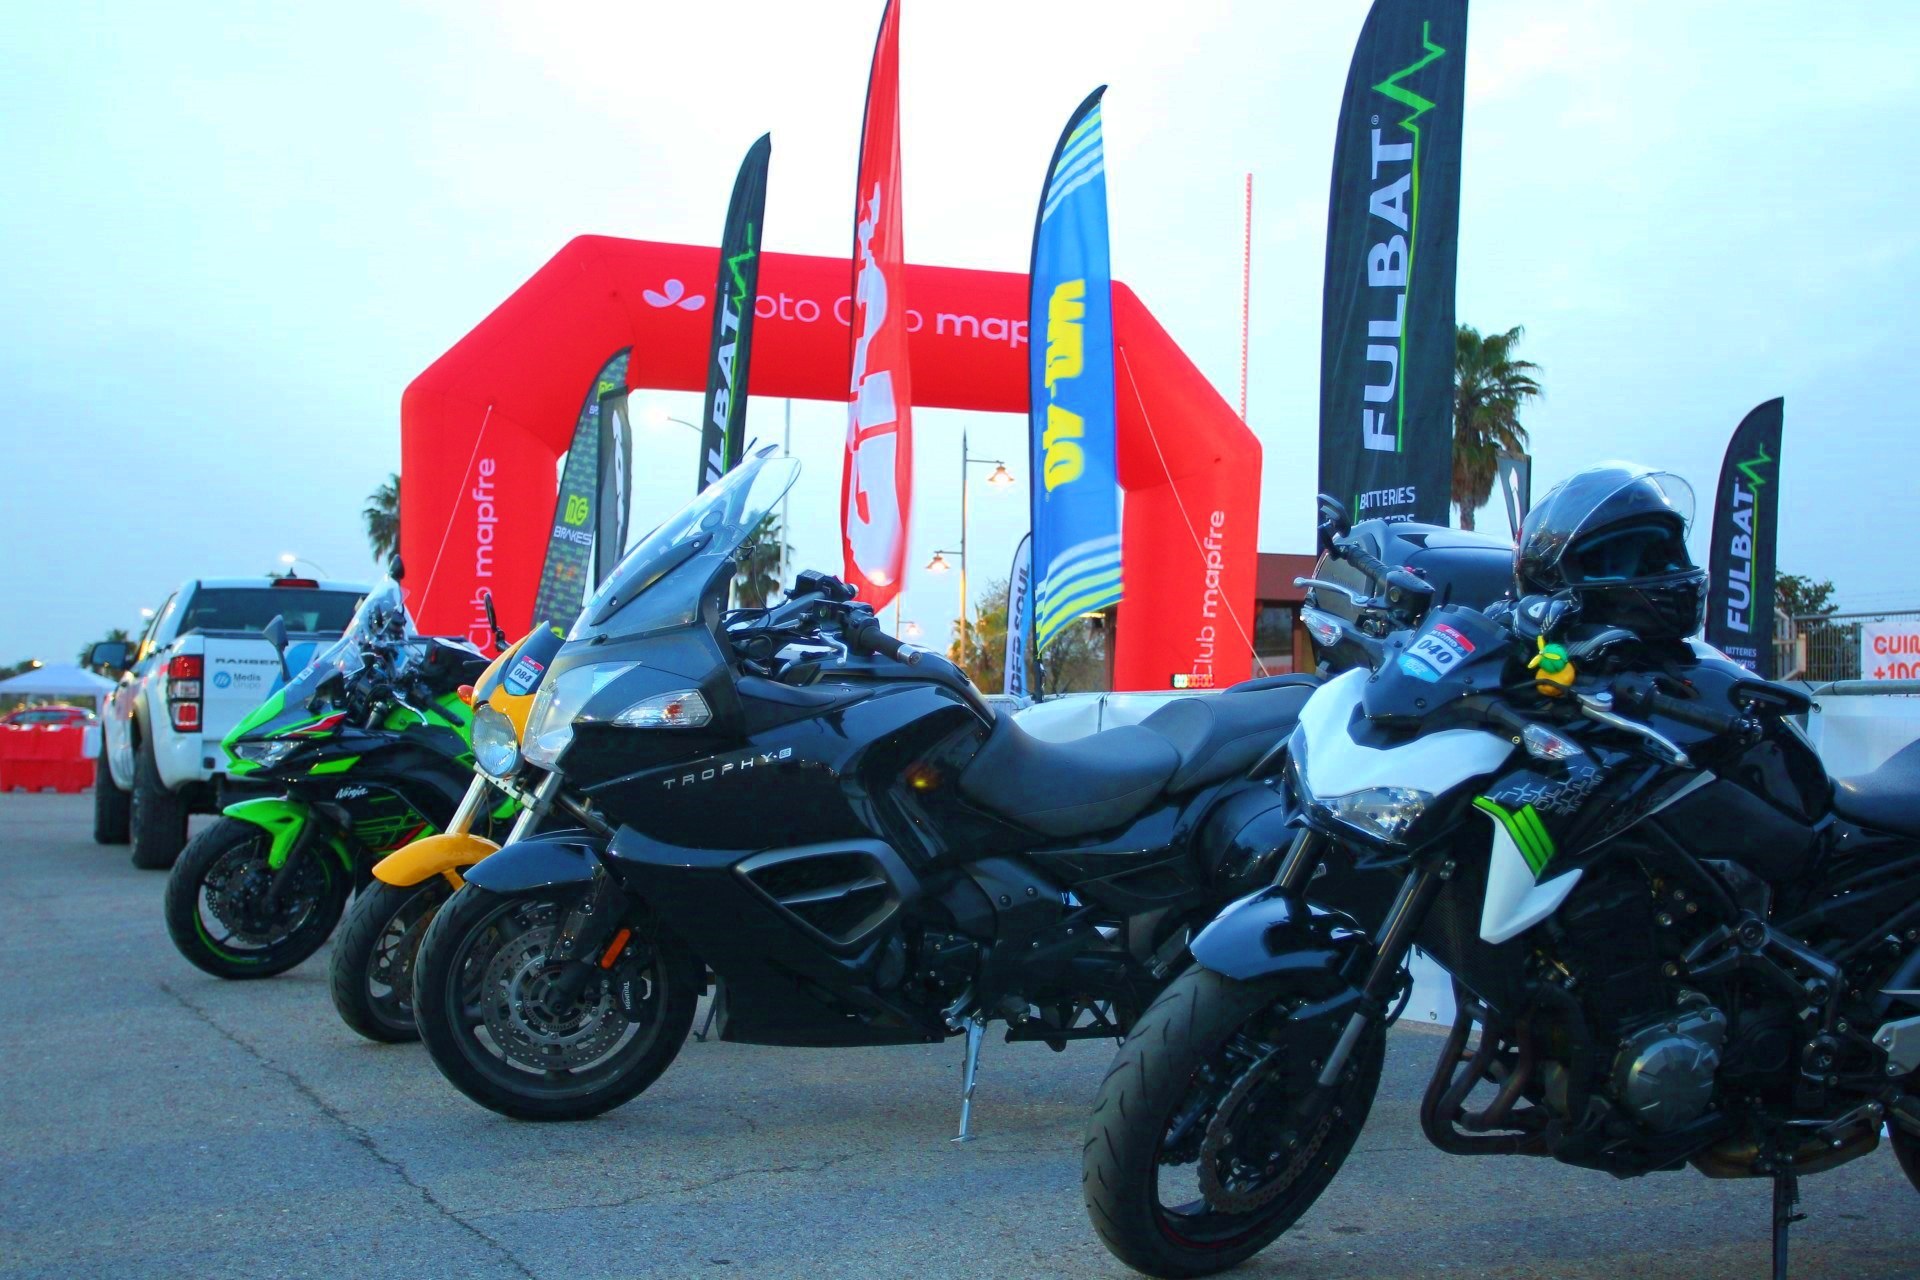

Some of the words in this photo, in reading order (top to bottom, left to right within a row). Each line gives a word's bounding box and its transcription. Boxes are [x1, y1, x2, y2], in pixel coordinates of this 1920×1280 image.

[1363, 128, 1412, 453] FULBAT
[755, 295, 820, 322] oto
[936, 311, 1028, 348] map
[706, 293, 741, 484] LBAT
[472, 458, 499, 577] mapfre
[553, 525, 593, 546] BRAKES
[1203, 510, 1225, 618] mapfre
[1727, 482, 1754, 633] FULBAT
[1014, 563, 1031, 630] SOUL
[513, 667, 533, 683] 084
[1416, 639, 1454, 665] 040
[335, 785, 369, 799] Ninja
[663, 751, 773, 790] TROPHY
[623, 980, 632, 1010] TRIUMPH
